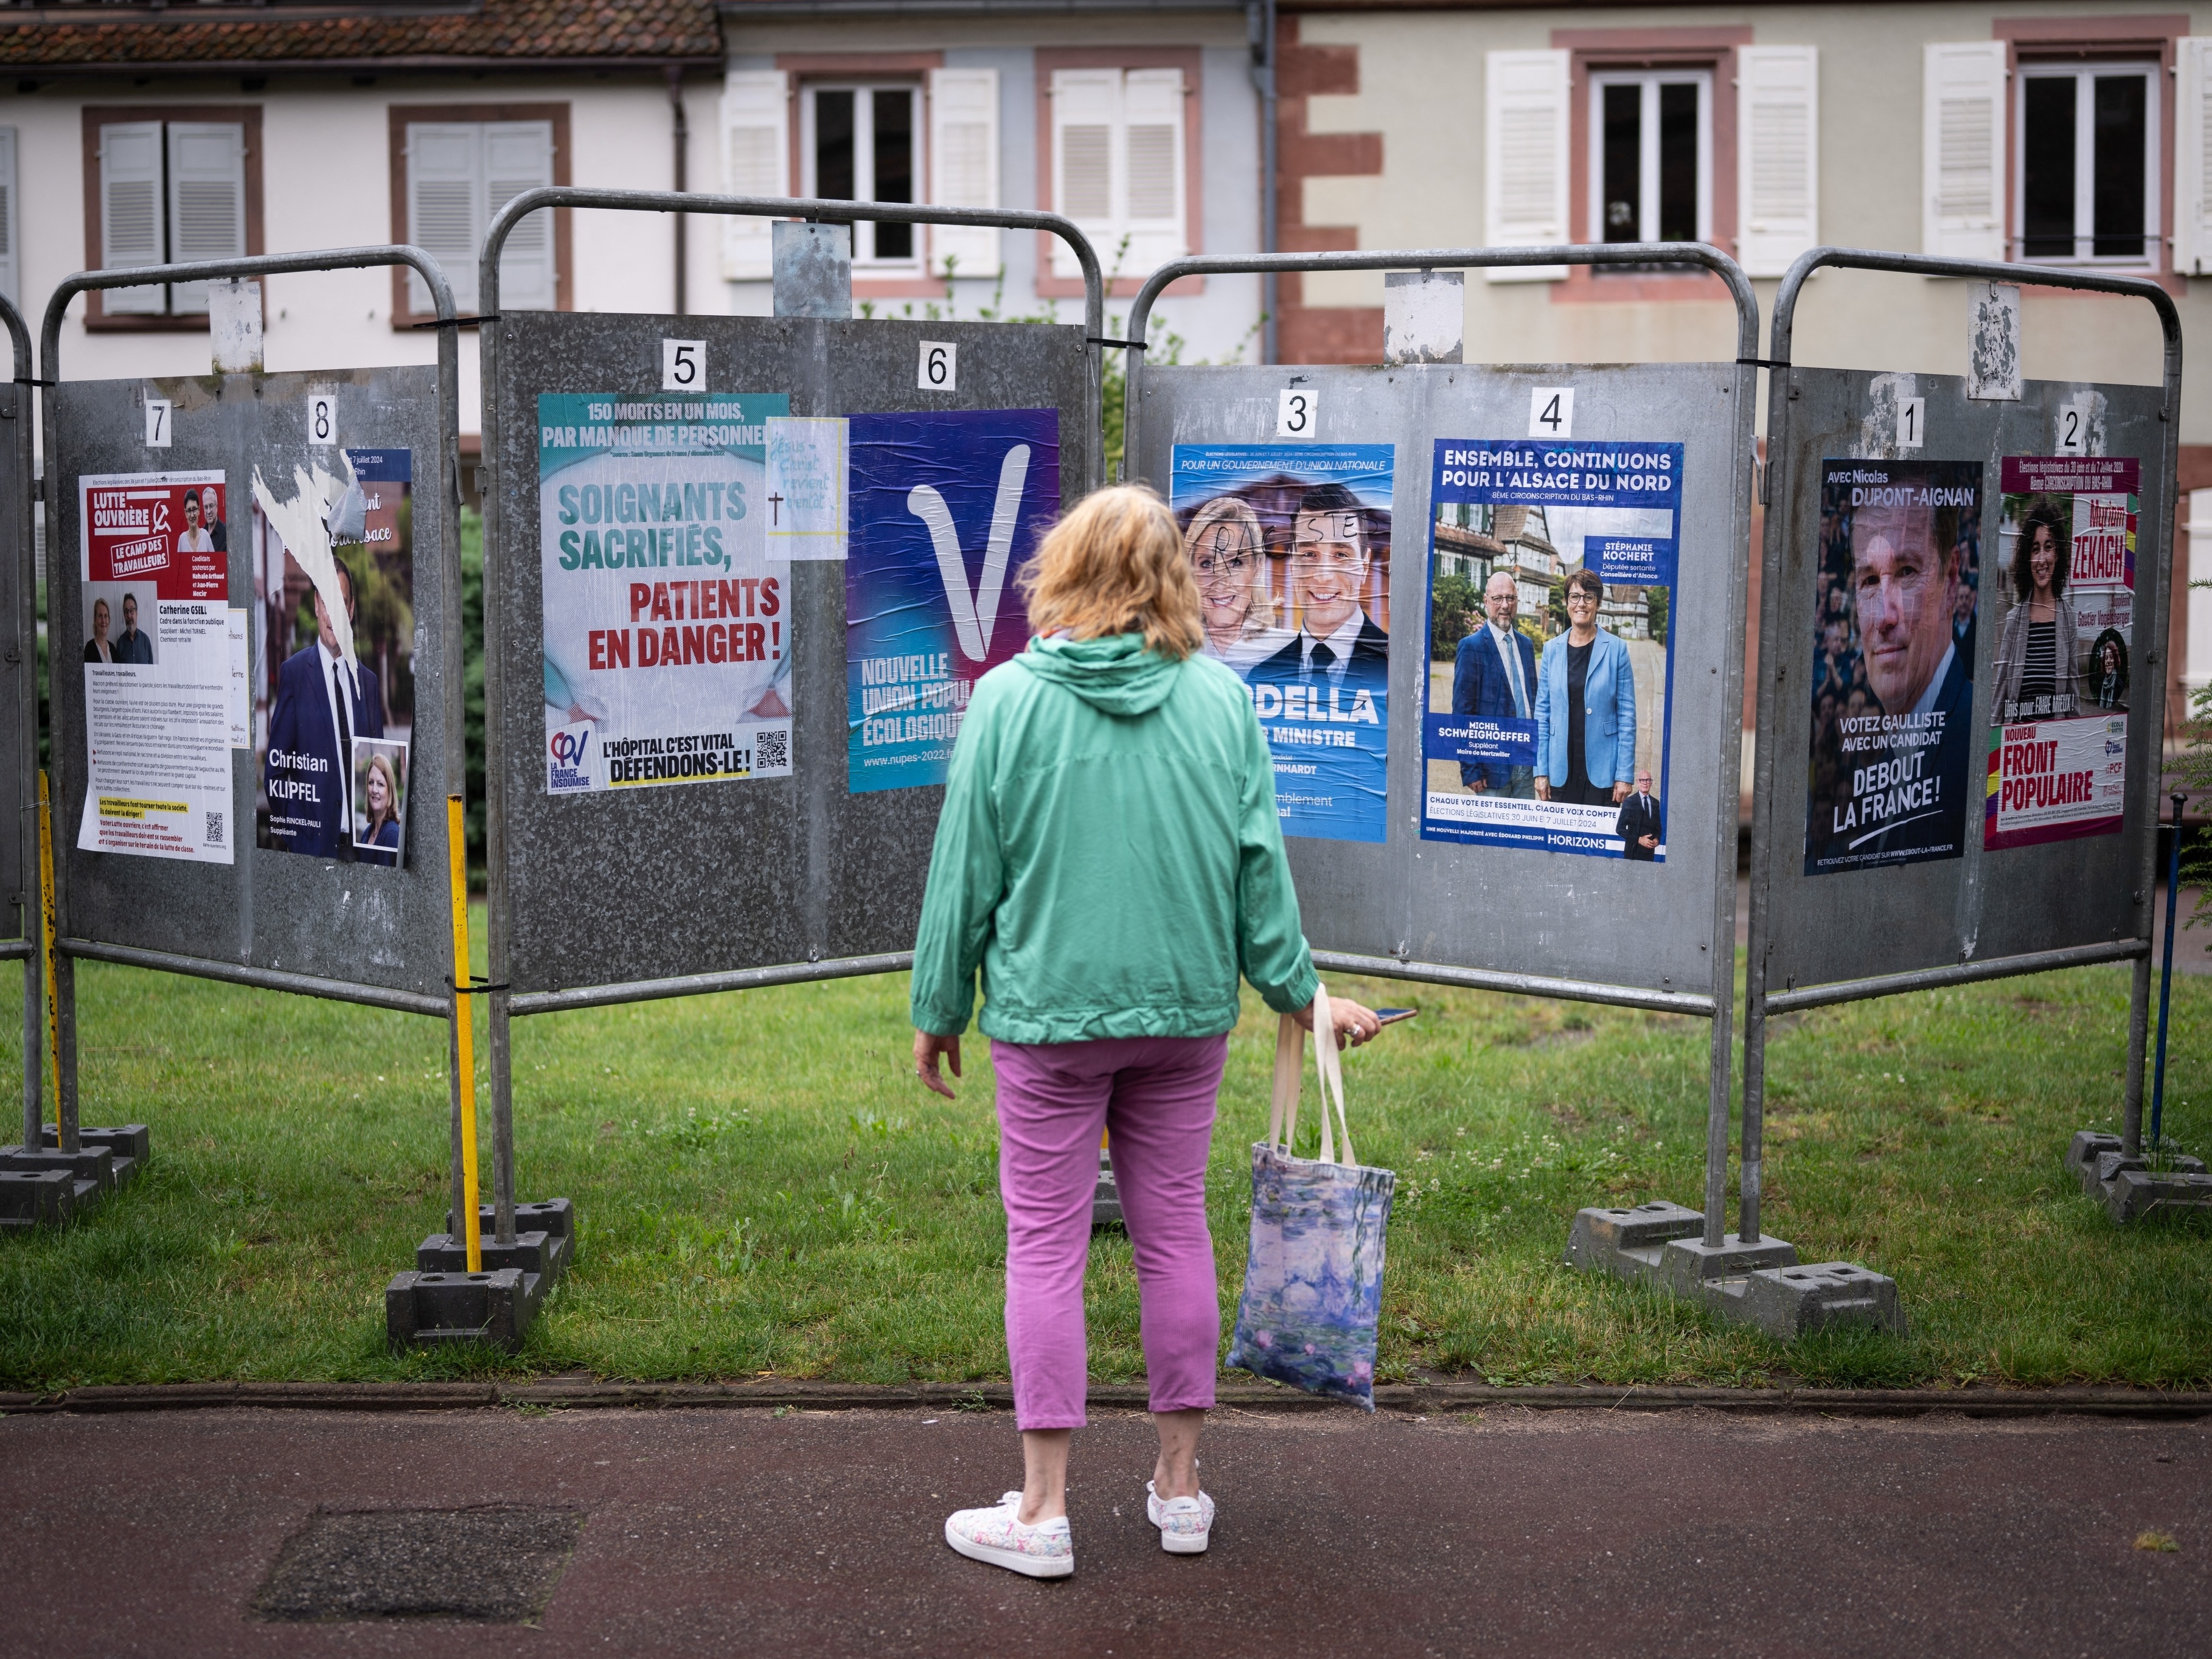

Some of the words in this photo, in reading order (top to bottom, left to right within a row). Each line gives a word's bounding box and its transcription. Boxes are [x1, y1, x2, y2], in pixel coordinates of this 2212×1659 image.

[673, 346, 695, 384] 5
[928, 348, 947, 384] 6
[153, 406, 164, 440] 7
[315, 401, 329, 439] 8
[588, 403, 612, 420] 150
[614, 403, 662, 420] MORTS
[664, 403, 680, 420] EN
[685, 403, 702, 419] UN
[706, 402, 745, 423] MOIS,
[1287, 395, 1306, 431] 3
[1540, 394, 1562, 431] 4
[1905, 403, 1914, 441] 1
[542, 427, 577, 448] PAR
[580, 426, 655, 447] MANQUE
[658, 426, 676, 446] DE
[2065, 411, 2078, 447] 2
[1181, 461, 1205, 470] POUR
[1207, 461, 1220, 470] UN
[1222, 461, 1294, 470] GOUVERNEMENT
[1295, 461, 1334, 470] D'UNION
[1334, 461, 1385, 470] NATIONALE
[1444, 450, 1538, 468] ENSEMBLE,
[1544, 452, 1671, 470] CONTINUONS
[782, 473, 829, 490] revient
[1442, 471, 1490, 486] POUR
[1495, 473, 1579, 489] L'ALSACE
[1585, 474, 1609, 490] DU
[1616, 475, 1671, 491] NORD
[1828, 472, 1851, 483] AVEC
[1852, 470, 1888, 483] Nicolas
[94, 492, 126, 509] LUTTE
[558, 482, 746, 525] SOIGNANTS
[1492, 490, 1509, 499] 8ÈME
[1510, 492, 1569, 500] CIRCONSCRIPTION
[1852, 487, 1974, 507] DUPONT-AIGNAN
[94, 506, 149, 527] OUVRIÈRE
[116, 547, 124, 559] LE
[125, 542, 147, 557] CAMP
[147, 539, 162, 552] DES
[559, 524, 731, 572] SACRIFIÉS,
[1603, 551, 1654, 562] KOCHERT
[1605, 541, 1652, 551] STÉPHANIE
[1602, 563, 1628, 572] Députée
[2073, 535, 2123, 579] ZEKAGH
[159, 605, 189, 614] Catherine
[630, 577, 780, 622] PATIENTS
[2078, 611, 2096, 627] Gautier
[589, 629, 630, 670] EN
[638, 622, 765, 667] DANGER
[862, 653, 948, 686] NOUVELLE
[863, 685, 915, 716] UNION
[922, 679, 978, 709] POPUL
[2005, 700, 2018, 718] Unis
[2035, 695, 2051, 715] FAIRE
[2052, 694, 2071, 713] MIEUX
[1469, 722, 1499, 731] MICHEL
[1840, 715, 1880, 734] VOTEZ
[1882, 711, 1946, 731] GAULLISTE
[1273, 728, 1355, 747] MINISTRE
[1439, 728, 1530, 742] SCHWEIGHOEFFER
[1842, 737, 1871, 752] AVEC
[1873, 736, 1887, 750] UN
[1890, 731, 1942, 748] CANDIDAT
[2005, 726, 2036, 742] NOUVEAU
[603, 737, 664, 758] L'HÔPITAL
[667, 735, 698, 753] C'EST
[700, 733, 734, 751] VITAL
[1469, 741, 1498, 750] Suppléant
[270, 749, 328, 773] Christian
[610, 751, 742, 783] DÉFENDONS-LE
[2003, 740, 2058, 777] FRONT
[2109, 763, 2122, 774] PCF
[551, 768, 577, 781] FRANCE
[1854, 751, 1925, 797] DEBOUT
[270, 780, 321, 803] KLIPFEL
[2001, 770, 2093, 812] POPULAIRE
[1430, 806, 1464, 816] ÉLECTIONS
[1467, 810, 1509, 820] LÉGISLATIVES
[1495, 802, 1534, 811] ESSENTIEL,
[1834, 802, 1856, 833] LA
[1862, 778, 1933, 825] FRANCE
[270, 815, 285, 824] Sophie
[287, 817, 321, 828] RINCKEL-PAULI
[270, 827, 297, 836] Suppléante
[1548, 835, 1604, 849] HORIZONS
[1860, 852, 1880, 861] CANDIDAT
